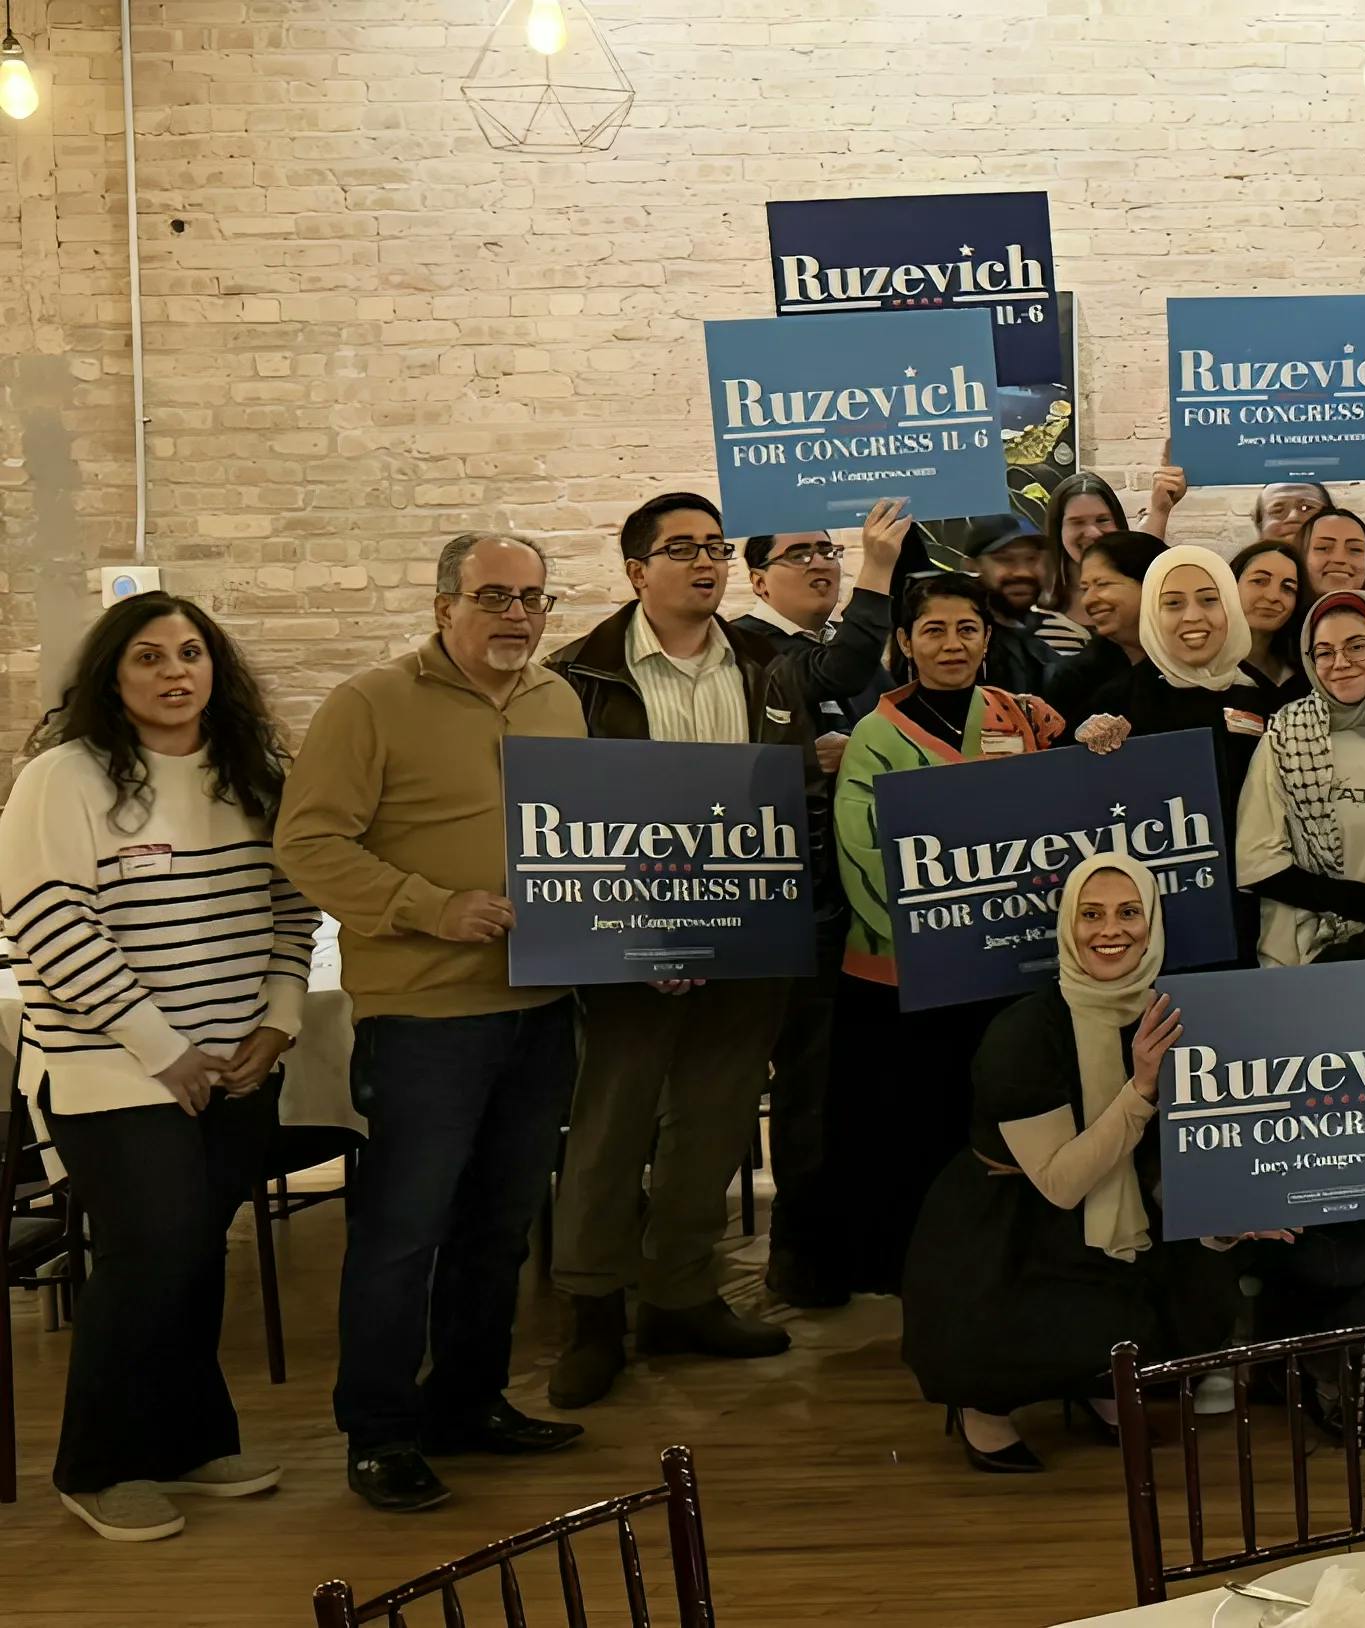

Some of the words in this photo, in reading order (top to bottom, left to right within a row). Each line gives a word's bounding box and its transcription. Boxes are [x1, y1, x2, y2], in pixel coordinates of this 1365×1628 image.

[779, 244, 1045, 301] Ruzevich
[996, 304, 1044, 326] IL-6
[721, 365, 988, 428] Ruzevich
[1184, 406, 1231, 427] FOR
[1239, 402, 1365, 424] CONGRESS
[733, 443, 786, 467] FOR
[795, 432, 934, 462] CONGRESS
[517, 802, 799, 858] Ruzevich
[892, 796, 1214, 892] Ruzevich
[526, 878, 582, 903] FOR
[592, 878, 740, 903] CONGRESS
[748, 878, 798, 900] IL-6
[910, 903, 973, 933] FOR
[1178, 1121, 1243, 1153] FOR
